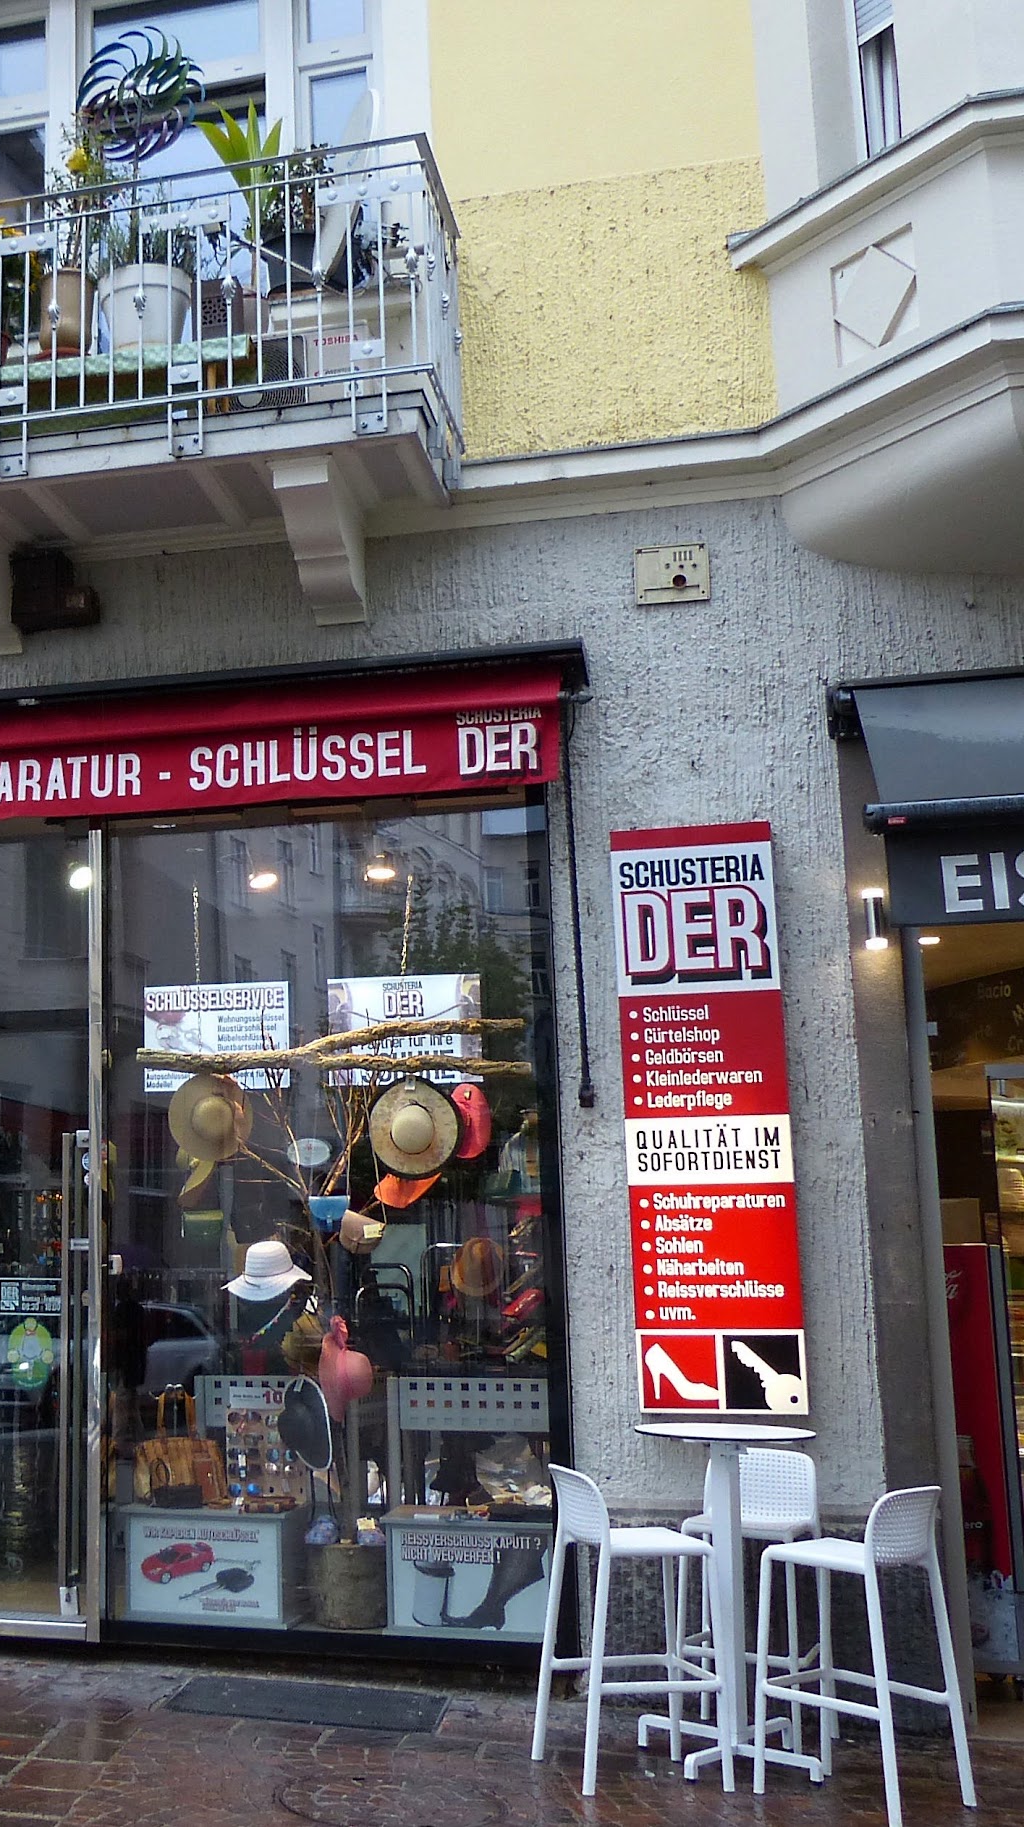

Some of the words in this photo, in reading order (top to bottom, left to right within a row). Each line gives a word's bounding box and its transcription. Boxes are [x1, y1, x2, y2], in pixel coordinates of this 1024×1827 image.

[313, 335, 358, 346] TOSHIBA
[456, 707, 542, 726] SCHUSTERIA
[457, 721, 539, 777] DER
[189, 726, 427, 792] SCHLÜSSEL
[619, 853, 765, 889] SCHUSTERIA
[940, 852, 1024, 914] EI
[620, 884, 772, 986] DER
[382, 981, 423, 992] SCHUSTERIA
[145, 986, 285, 1012] SCHLÜSSELSERVICE
[382, 989, 425, 1018] DER
[643, 1004, 710, 1022] Schlüssel
[643, 1026, 720, 1044] Gürtelshop
[645, 1047, 724, 1065] Geldbörsen
[646, 1068, 763, 1087] Kleinlederwaren
[647, 1090, 732, 1110] Lederpflege
[636, 1124, 741, 1150] QUALITÄT
[754, 1126, 780, 1147] IM
[637, 1149, 781, 1172] SOFORTDIENST
[652, 1192, 786, 1213] Schuhreparaturen
[654, 1214, 713, 1232] Absätze
[655, 1236, 704, 1254] Sohlen
[656, 1258, 745, 1277] Näharbeiten
[657, 1280, 785, 1299] Reissverschlüsse
[659, 1305, 696, 1321] uvm.
[401, 1532, 492, 1548] REISSVERSCHLUSS
[401, 1546, 429, 1561] NICHT
[433, 1547, 494, 1564] WEGWERFEN
